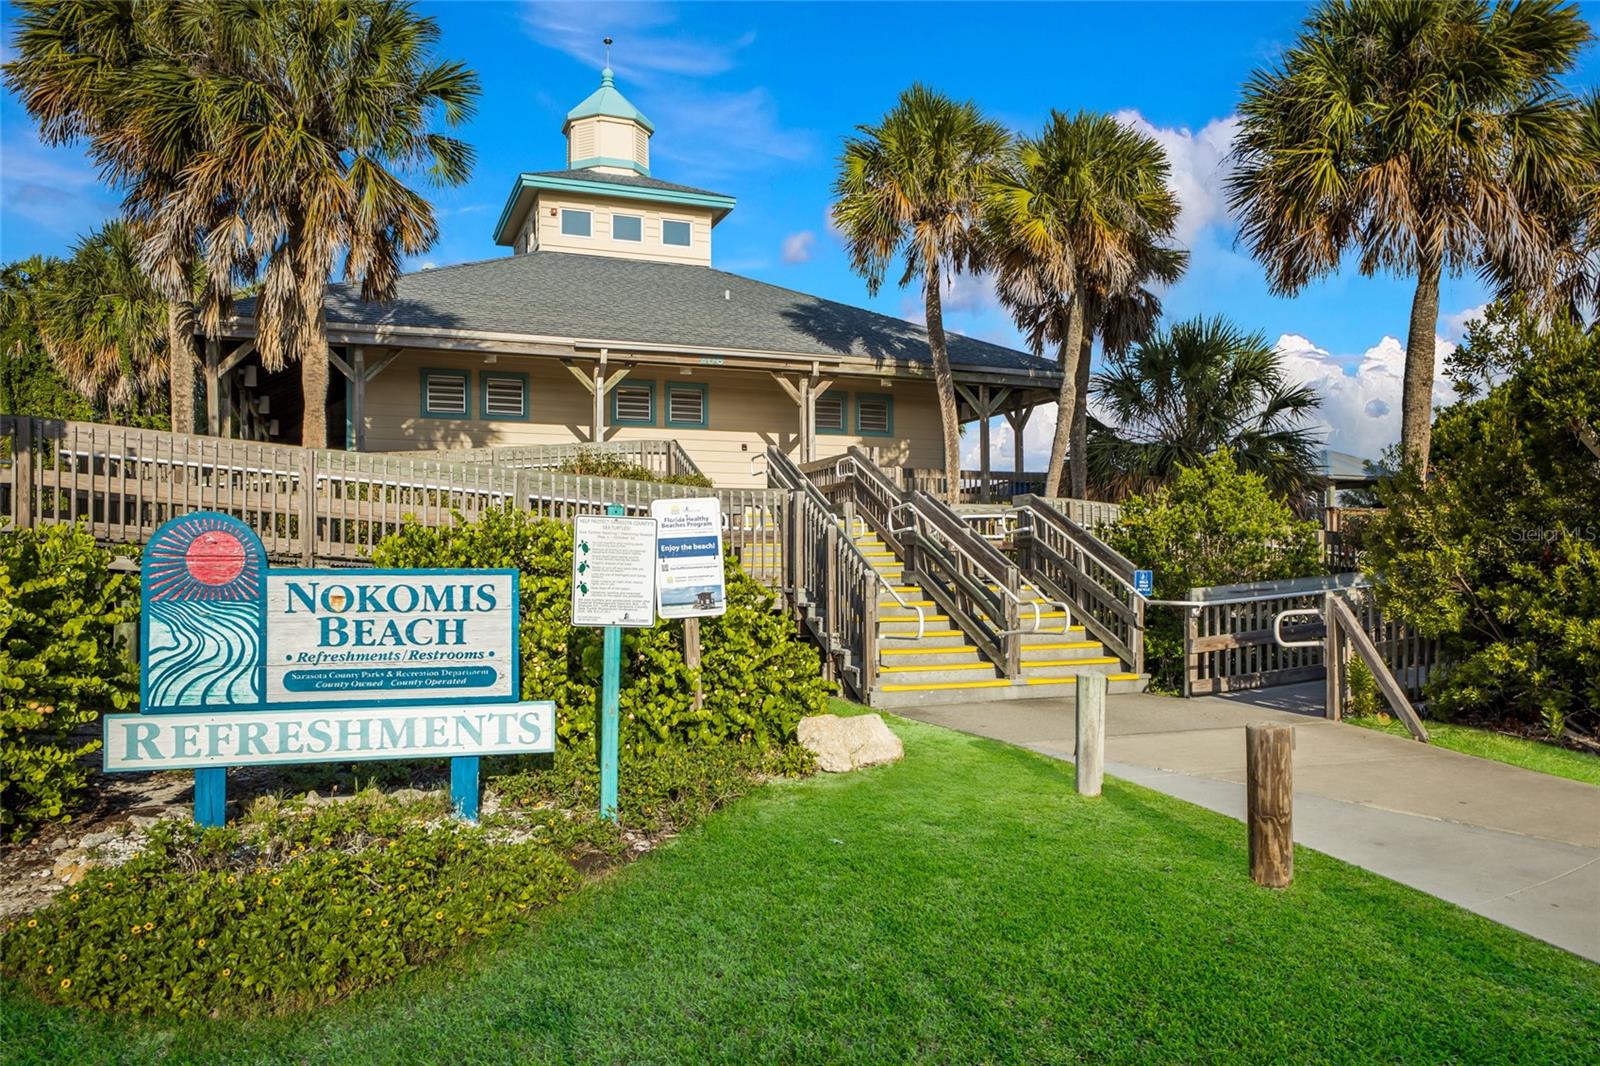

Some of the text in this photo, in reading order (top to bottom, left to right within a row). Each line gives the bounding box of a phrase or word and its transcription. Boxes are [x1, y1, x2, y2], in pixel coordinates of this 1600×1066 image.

[660, 542, 716, 553] Enjoy the beach!
[284, 582, 497, 614] NOKOMIS
[316, 616, 467, 647] BEACH
[315, 681, 350, 689] County
[390, 679, 423, 687] County
[424, 678, 467, 687] Operated
[328, 671, 359, 680] County
[386, 670, 393, 678] &
[395, 670, 439, 678] Recreation
[121, 712, 542, 762] REFRESHMENTS
